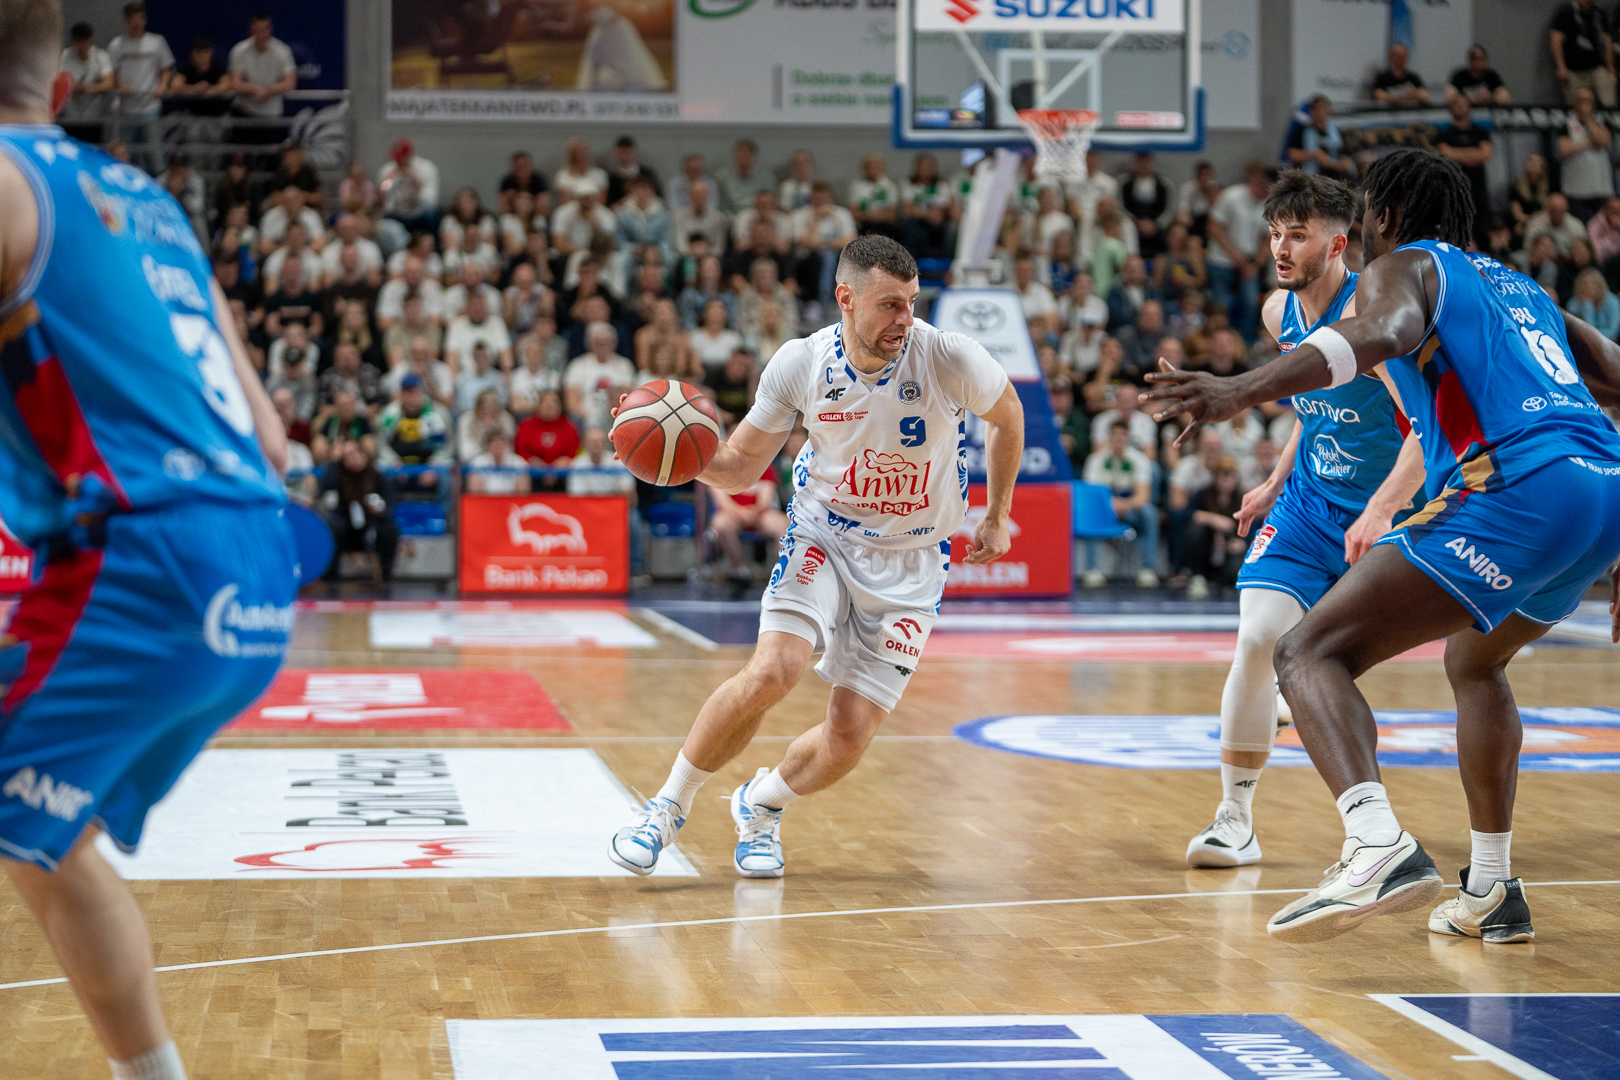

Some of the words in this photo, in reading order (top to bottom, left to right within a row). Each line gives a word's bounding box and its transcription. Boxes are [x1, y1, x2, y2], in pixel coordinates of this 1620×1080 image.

[826, 367, 834, 384] C
[825, 388, 846, 401] 4F
[899, 416, 927, 448] 9
[834, 455, 932, 498] Anwil
[882, 494, 929, 515] ORLEN
[1445, 536, 1513, 590] ANIRO
[885, 639, 921, 658] ORLEN
[1234, 780, 1257, 788] 4F
